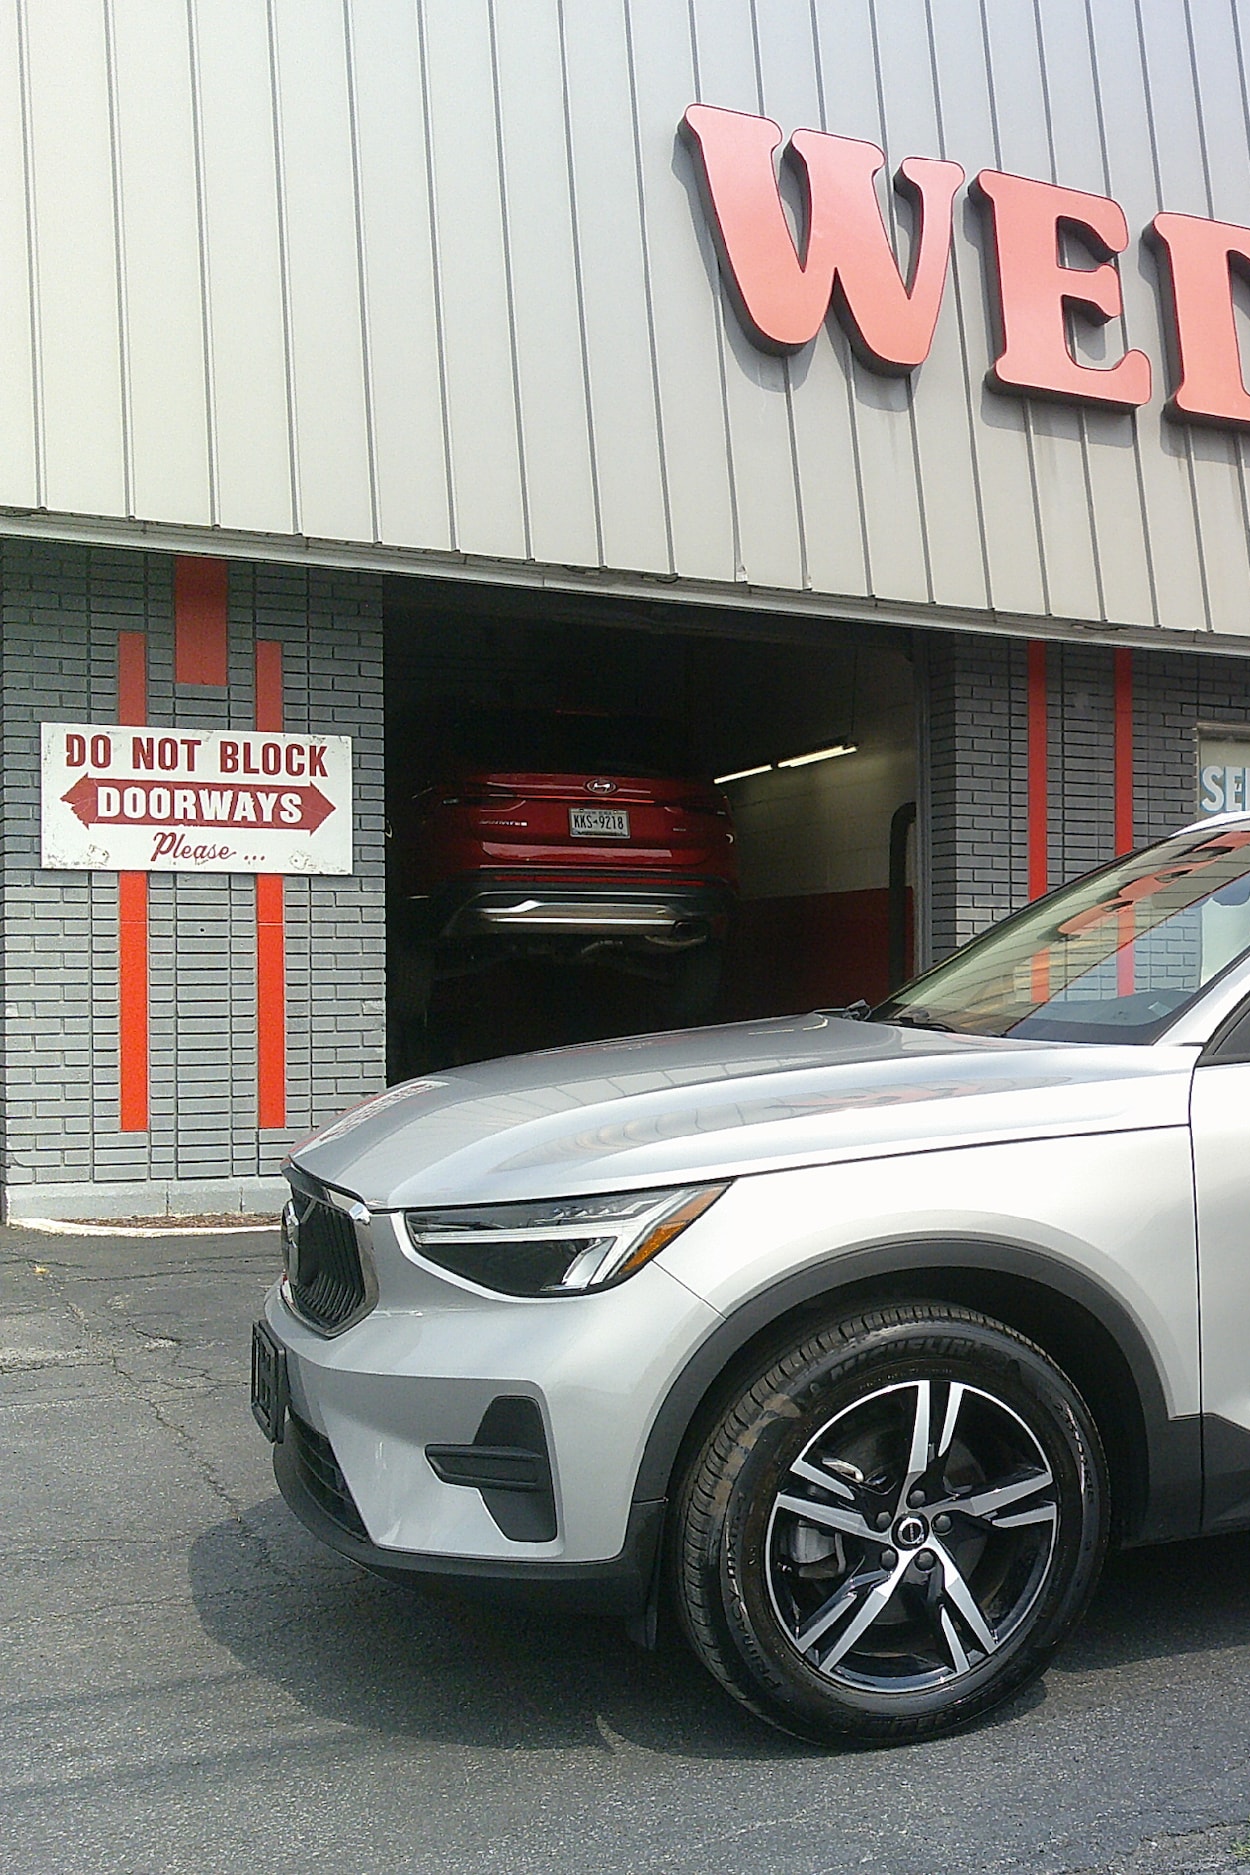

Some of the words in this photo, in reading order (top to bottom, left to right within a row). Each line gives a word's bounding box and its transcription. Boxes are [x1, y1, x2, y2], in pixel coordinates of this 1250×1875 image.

[65, 733, 112, 769] DO
[132, 737, 202, 772] NOT
[220, 741, 329, 778] BLOCK
[97, 786, 303, 825] DOORWAYS
